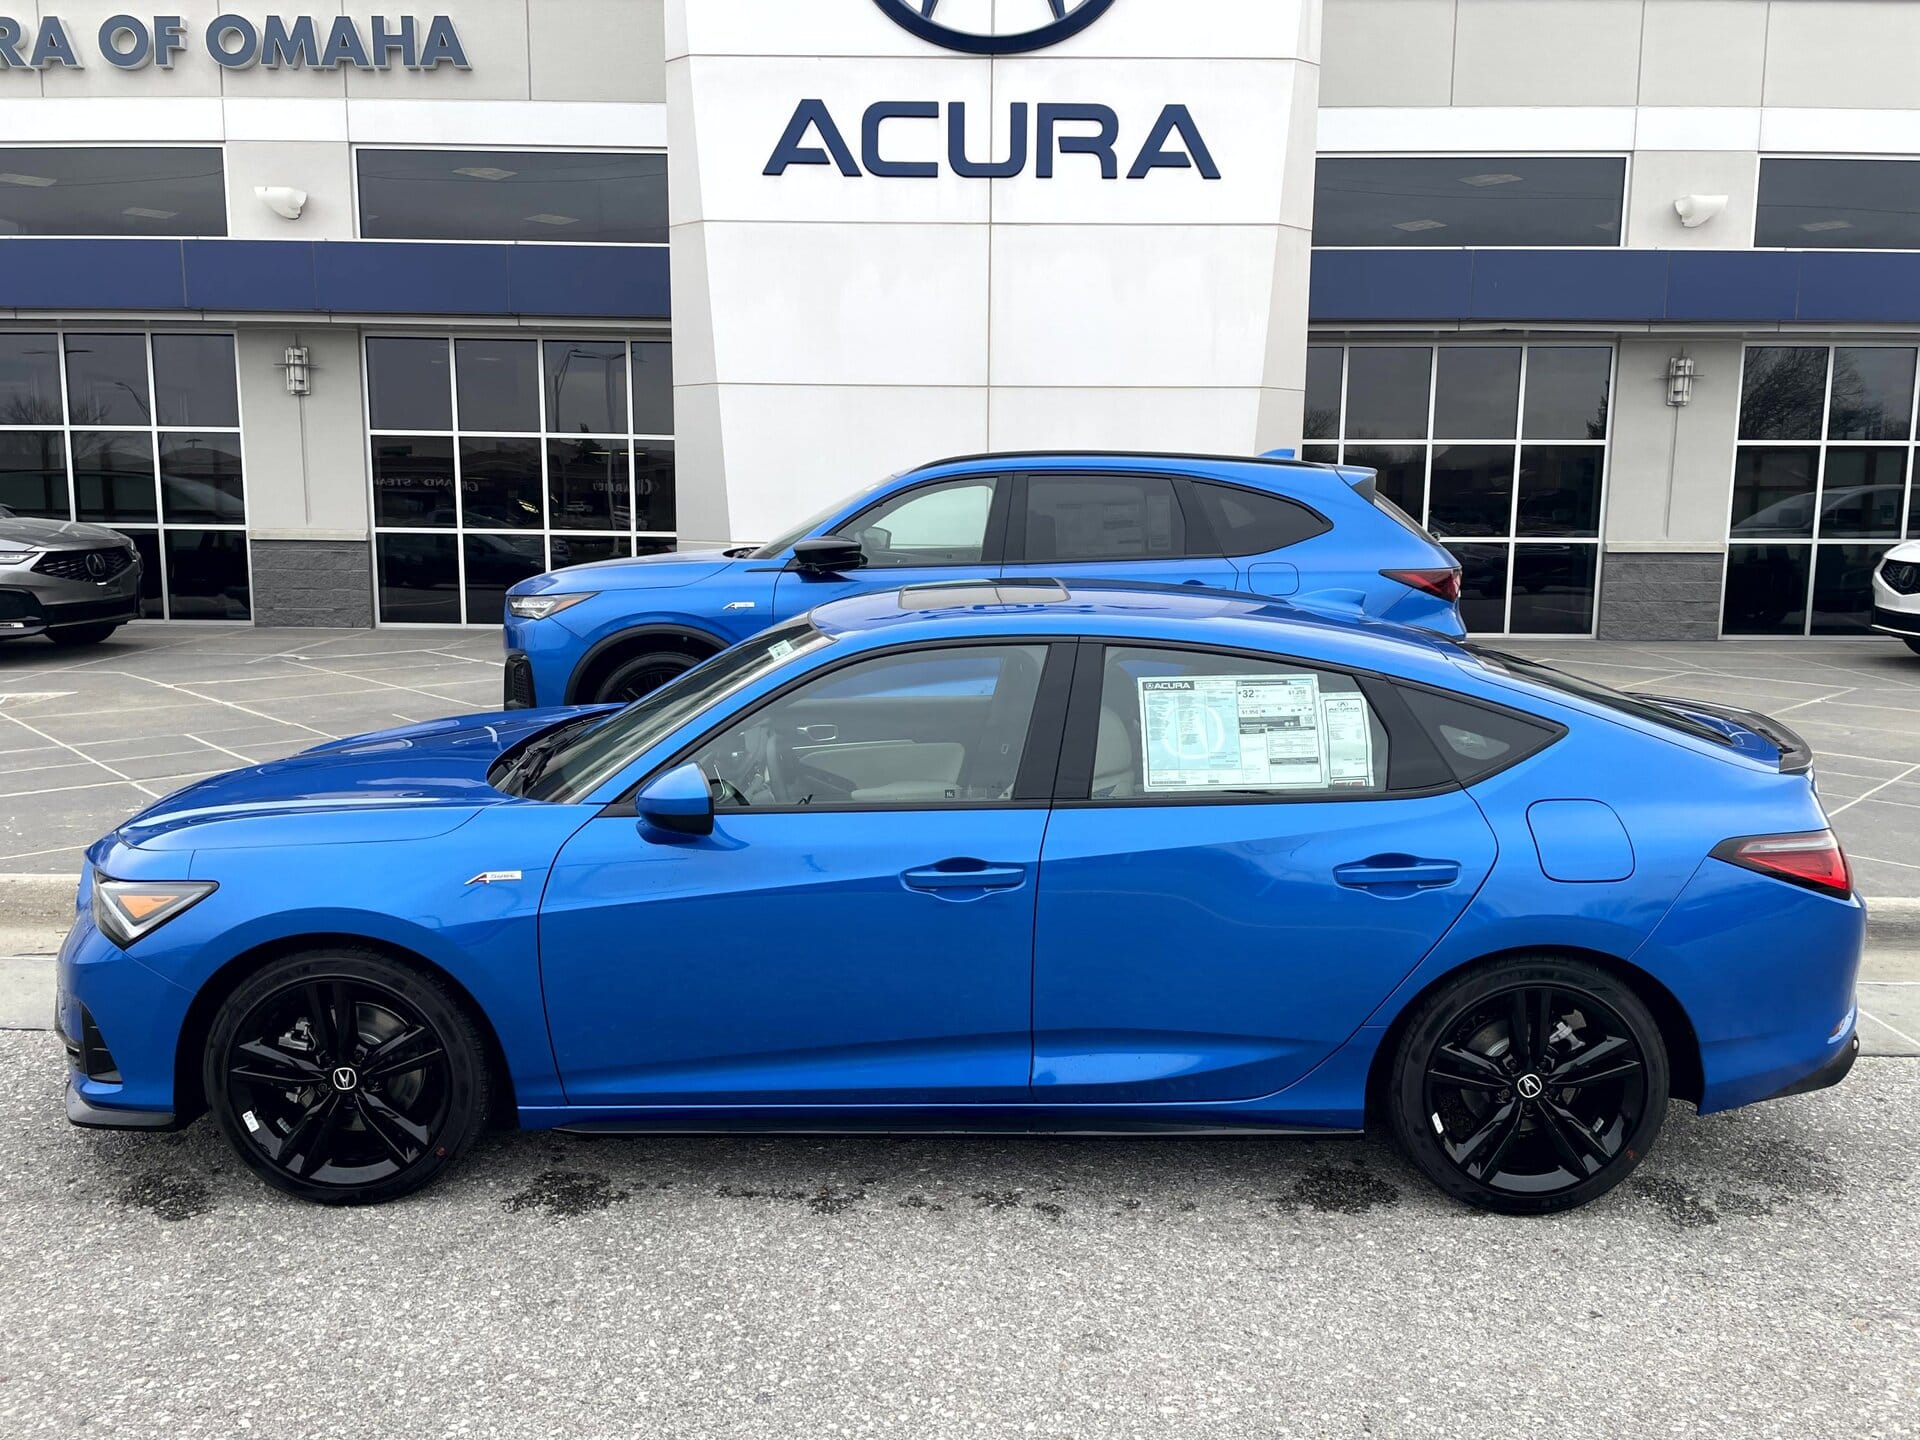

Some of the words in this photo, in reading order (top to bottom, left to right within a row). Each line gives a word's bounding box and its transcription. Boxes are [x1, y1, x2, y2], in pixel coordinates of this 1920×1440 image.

[98, 15, 186, 70] OF
[206, 15, 471, 70] OMAHA
[762, 99, 1221, 179] ACURA
[1154, 682, 1191, 690] ACURA
[1242, 689, 1255, 698] 32
